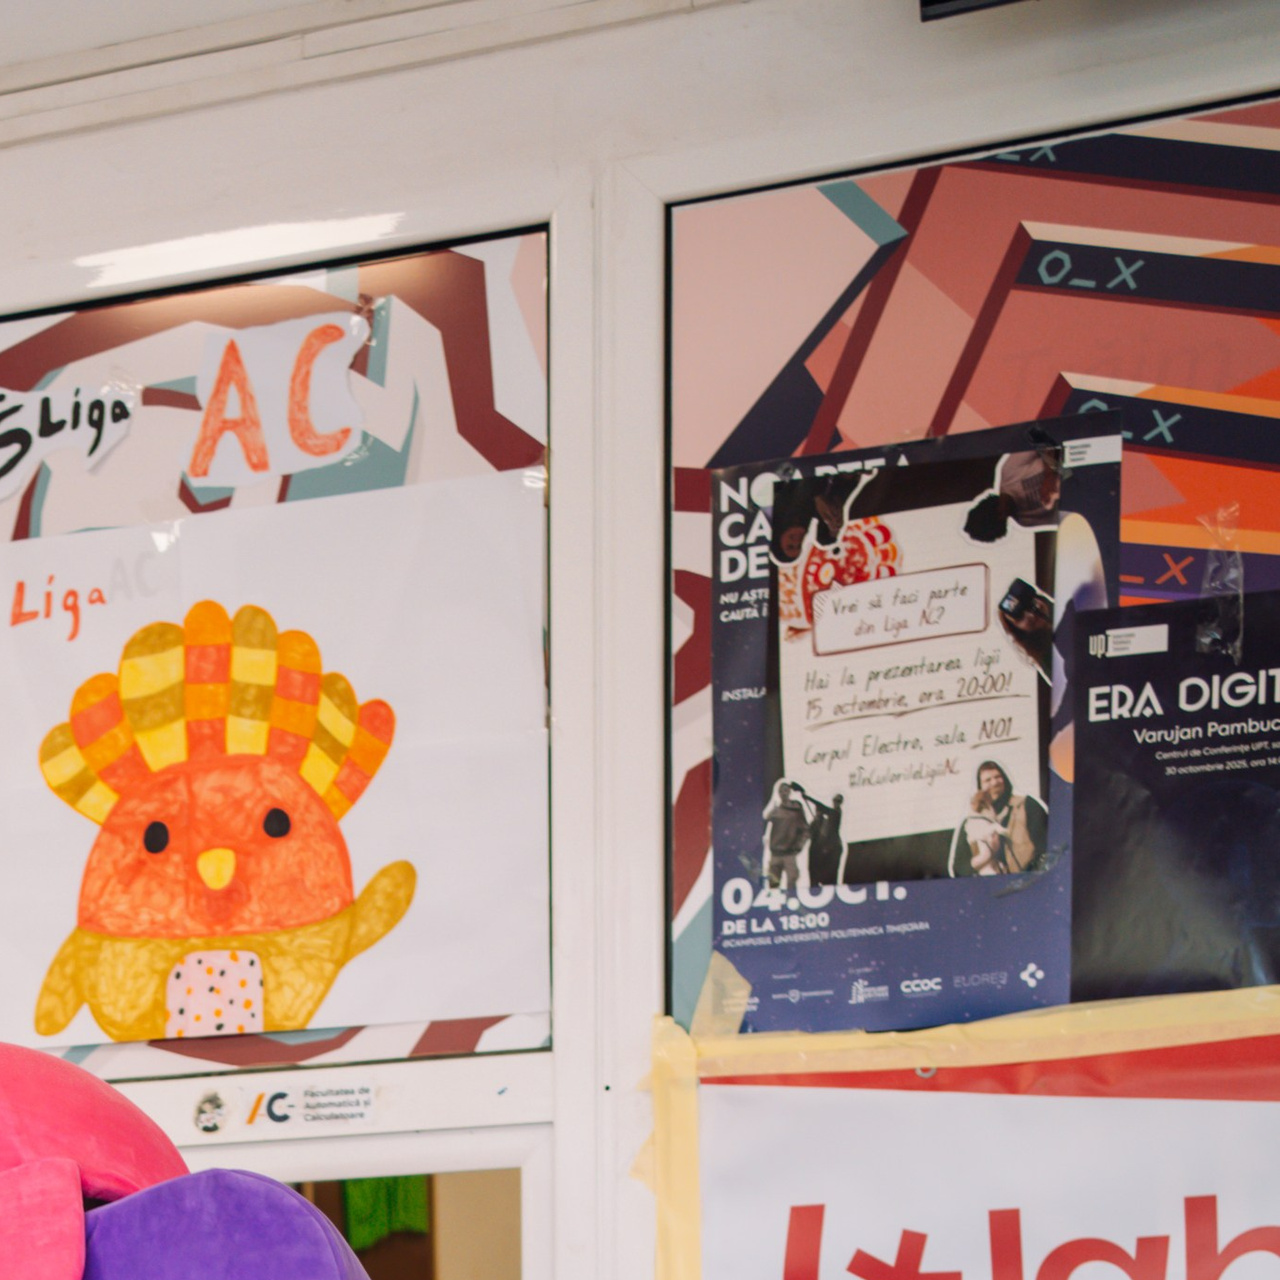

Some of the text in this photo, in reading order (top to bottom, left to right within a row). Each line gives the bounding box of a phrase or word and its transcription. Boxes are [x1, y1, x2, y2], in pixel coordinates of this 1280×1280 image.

[38, 323, 352, 477] Liga AC
[720, 545, 769, 583] DE
[10, 574, 107, 642] Liga
[831, 599, 858, 615] Vrei
[892, 588, 919, 606] faci
[929, 584, 968, 607] parte
[854, 620, 875, 637] din
[884, 615, 908, 638] Liga
[804, 647, 1001, 692] Hai la prezentarea ligii
[918, 689, 944, 703] ora
[956, 671, 1013, 699] 20:00!
[1088, 681, 1165, 723] ERA
[804, 741, 851, 770] Corpul
[934, 724, 966, 746] sala
[1133, 725, 1203, 745] Varujan
[722, 912, 830, 935] DE LA 18:00
